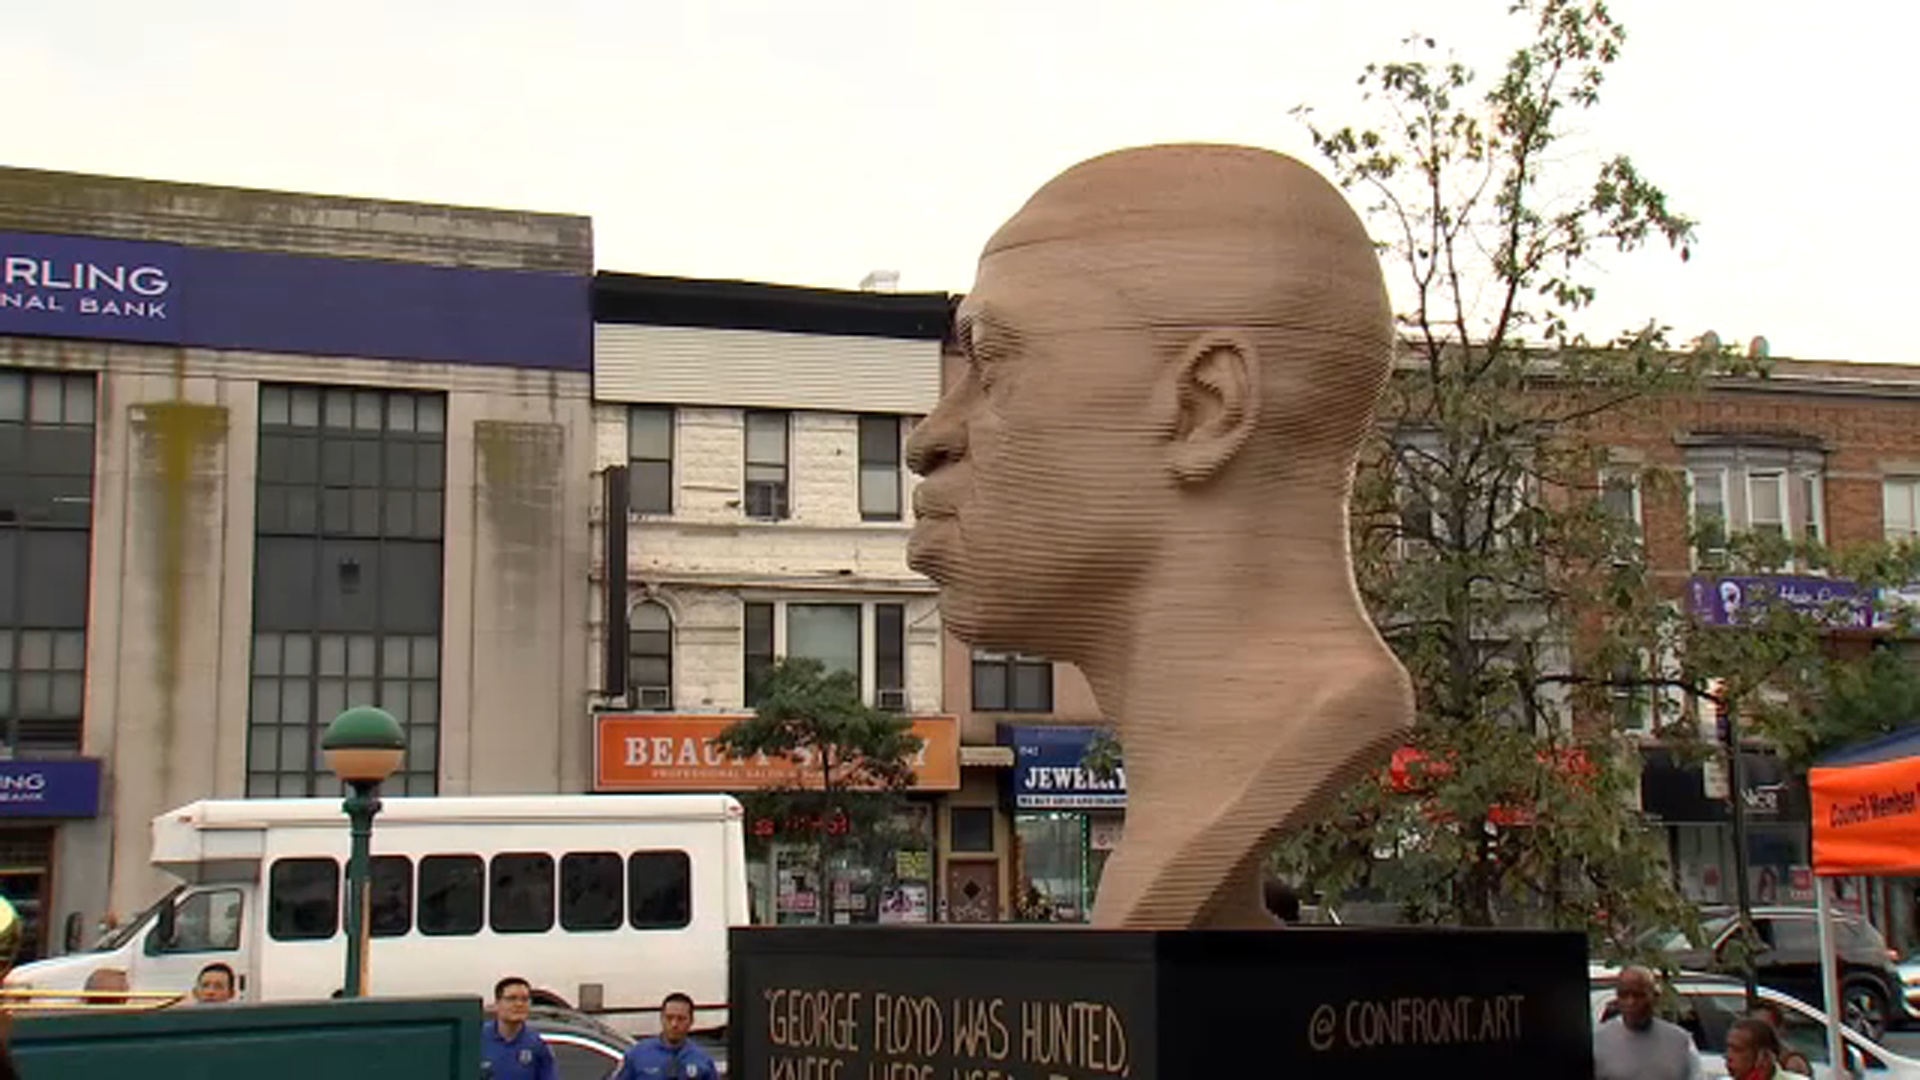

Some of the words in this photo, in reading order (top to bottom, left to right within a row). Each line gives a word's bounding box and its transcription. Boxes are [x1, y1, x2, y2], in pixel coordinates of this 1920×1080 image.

[5, 256, 169, 296] RLING
[0, 293, 64, 311] NAL
[80, 298, 166, 319] BANK
[624, 737, 771, 767] BEAU
[874, 993, 942, 1057] FLOYD
[953, 999, 1009, 1060] WAS
[1308, 1004, 1336, 1050] @
